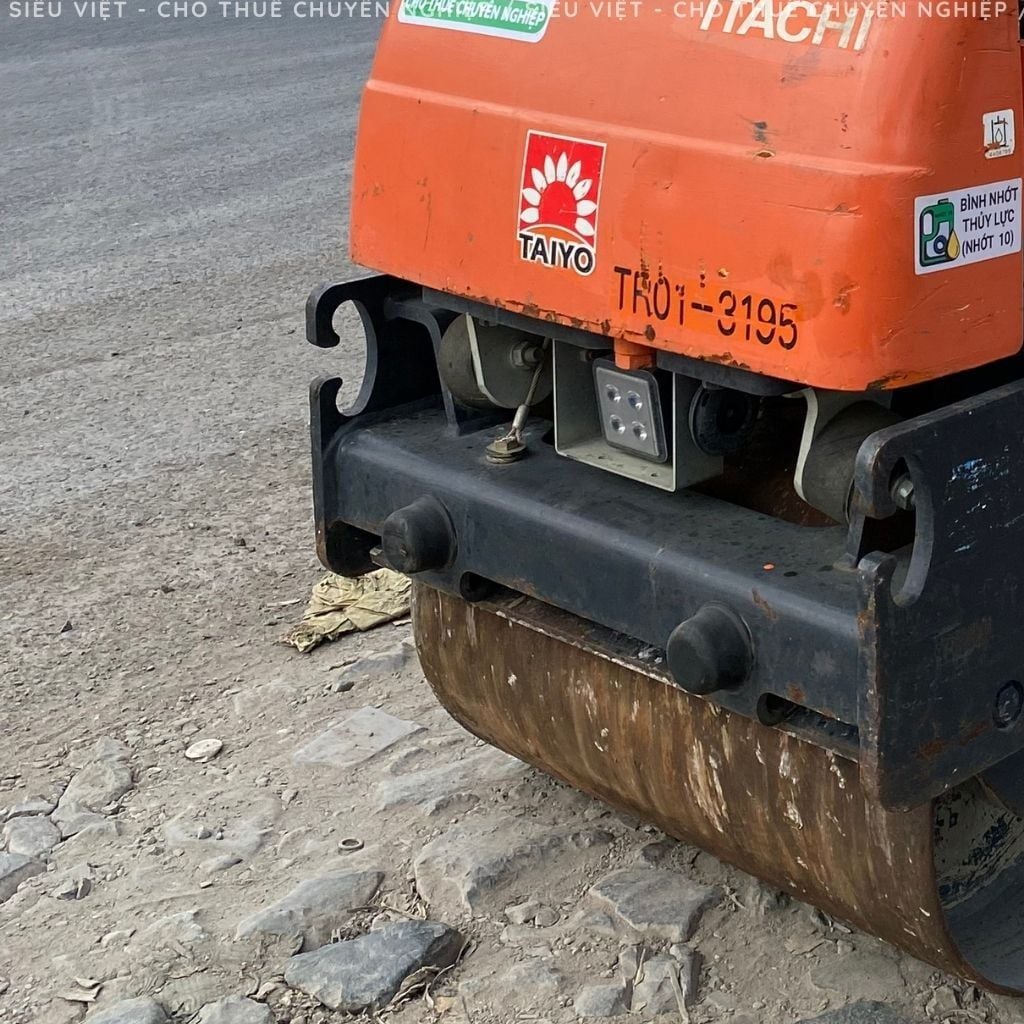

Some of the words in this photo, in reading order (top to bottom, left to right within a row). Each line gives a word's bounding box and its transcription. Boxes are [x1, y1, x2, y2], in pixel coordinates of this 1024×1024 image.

[960, 194, 987, 213] BÌNH
[989, 185, 1018, 206] NHỚT
[962, 211, 992, 233] THỦY
[994, 209, 1015, 227] LỰC
[518, 232, 594, 274] TAIYO
[962, 233, 994, 258] (NHỚT
[1000, 230, 1014, 247] 10)
